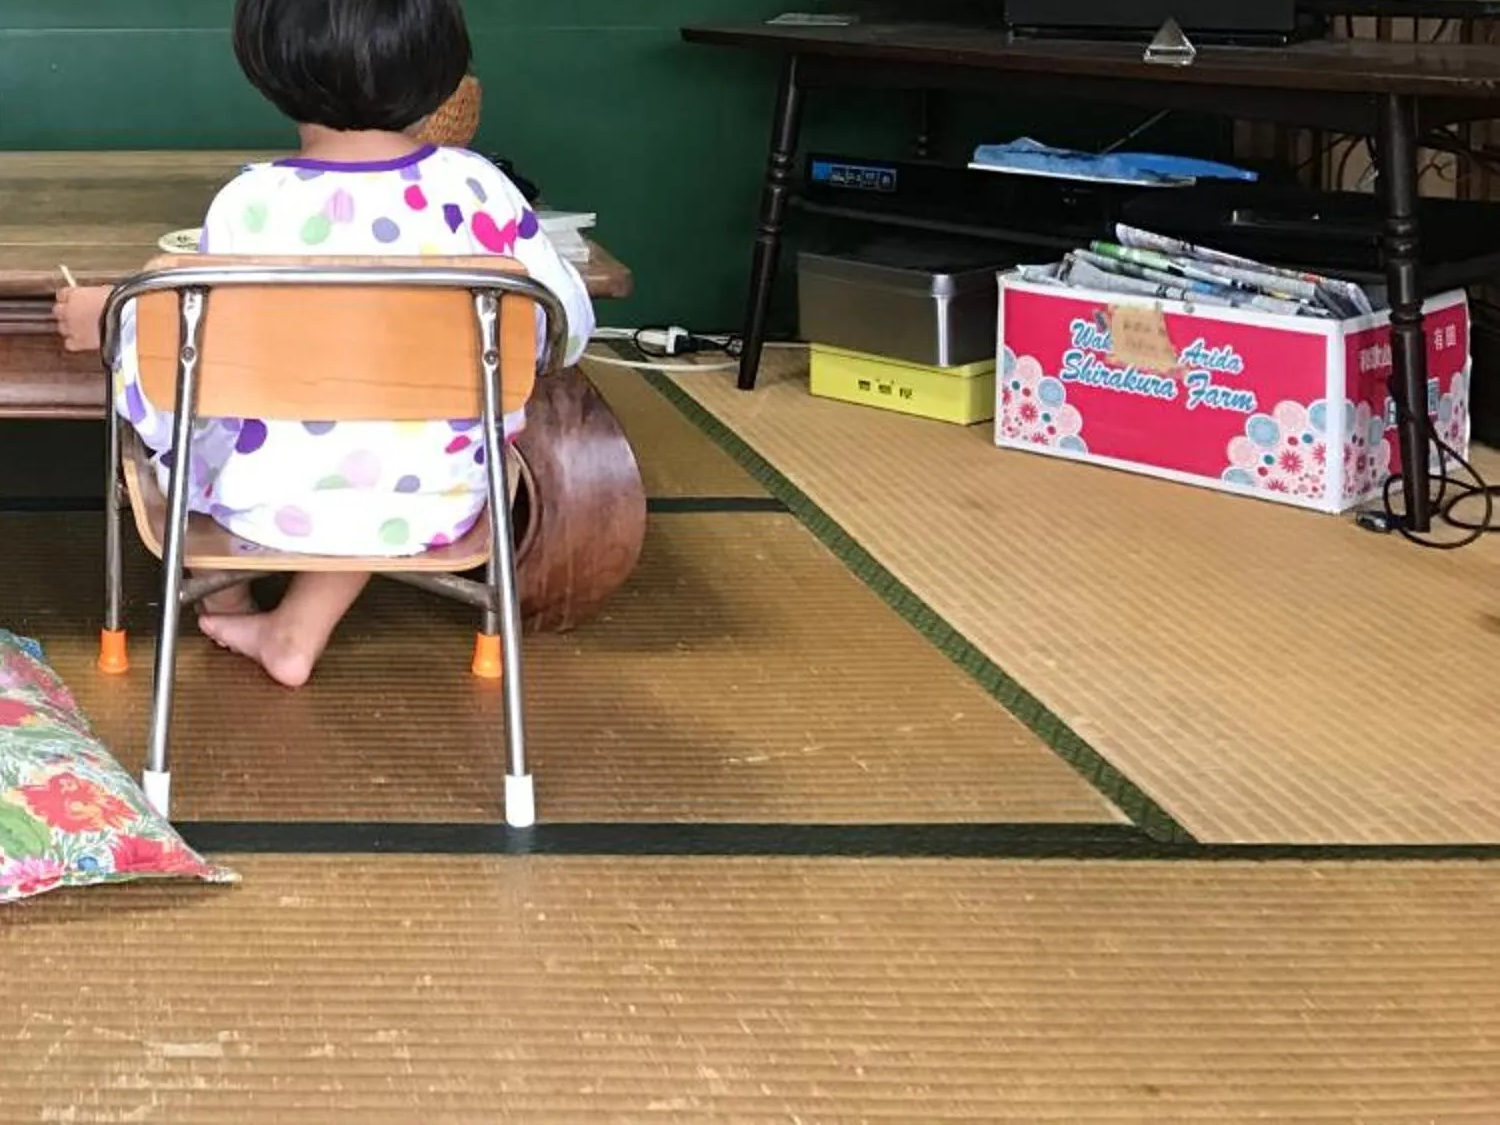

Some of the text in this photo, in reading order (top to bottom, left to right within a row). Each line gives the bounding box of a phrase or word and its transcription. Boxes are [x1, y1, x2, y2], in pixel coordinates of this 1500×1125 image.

[1061, 350, 1257, 409] Shirakura Farm
[1179, 340, 1243, 373] Arida
